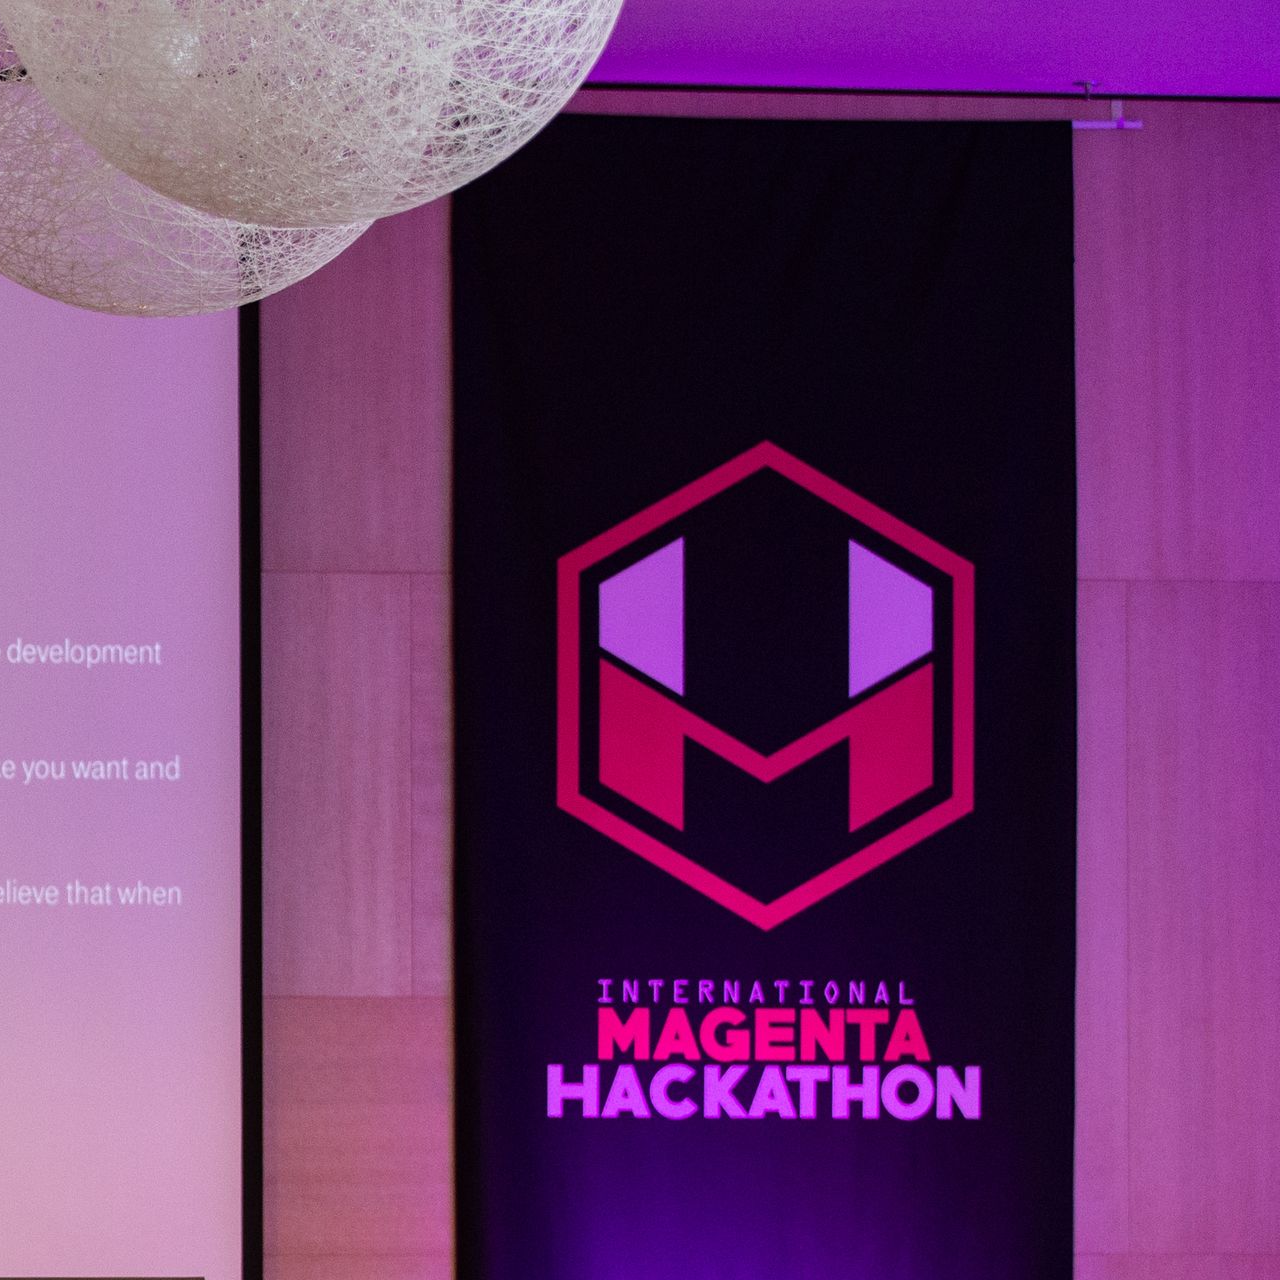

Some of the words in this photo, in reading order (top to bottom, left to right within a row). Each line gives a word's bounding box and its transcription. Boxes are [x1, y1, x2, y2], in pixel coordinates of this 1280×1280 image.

[6, 637, 162, 669] development
[21, 759, 66, 785] you
[71, 757, 129, 781] want
[134, 754, 181, 781] and
[66, 879, 112, 905] that
[117, 880, 182, 906] when
[597, 979, 916, 1005] INTERNATIONAL
[597, 1006, 931, 1062] MAGENTA
[547, 1063, 982, 1121] HACKATHON
